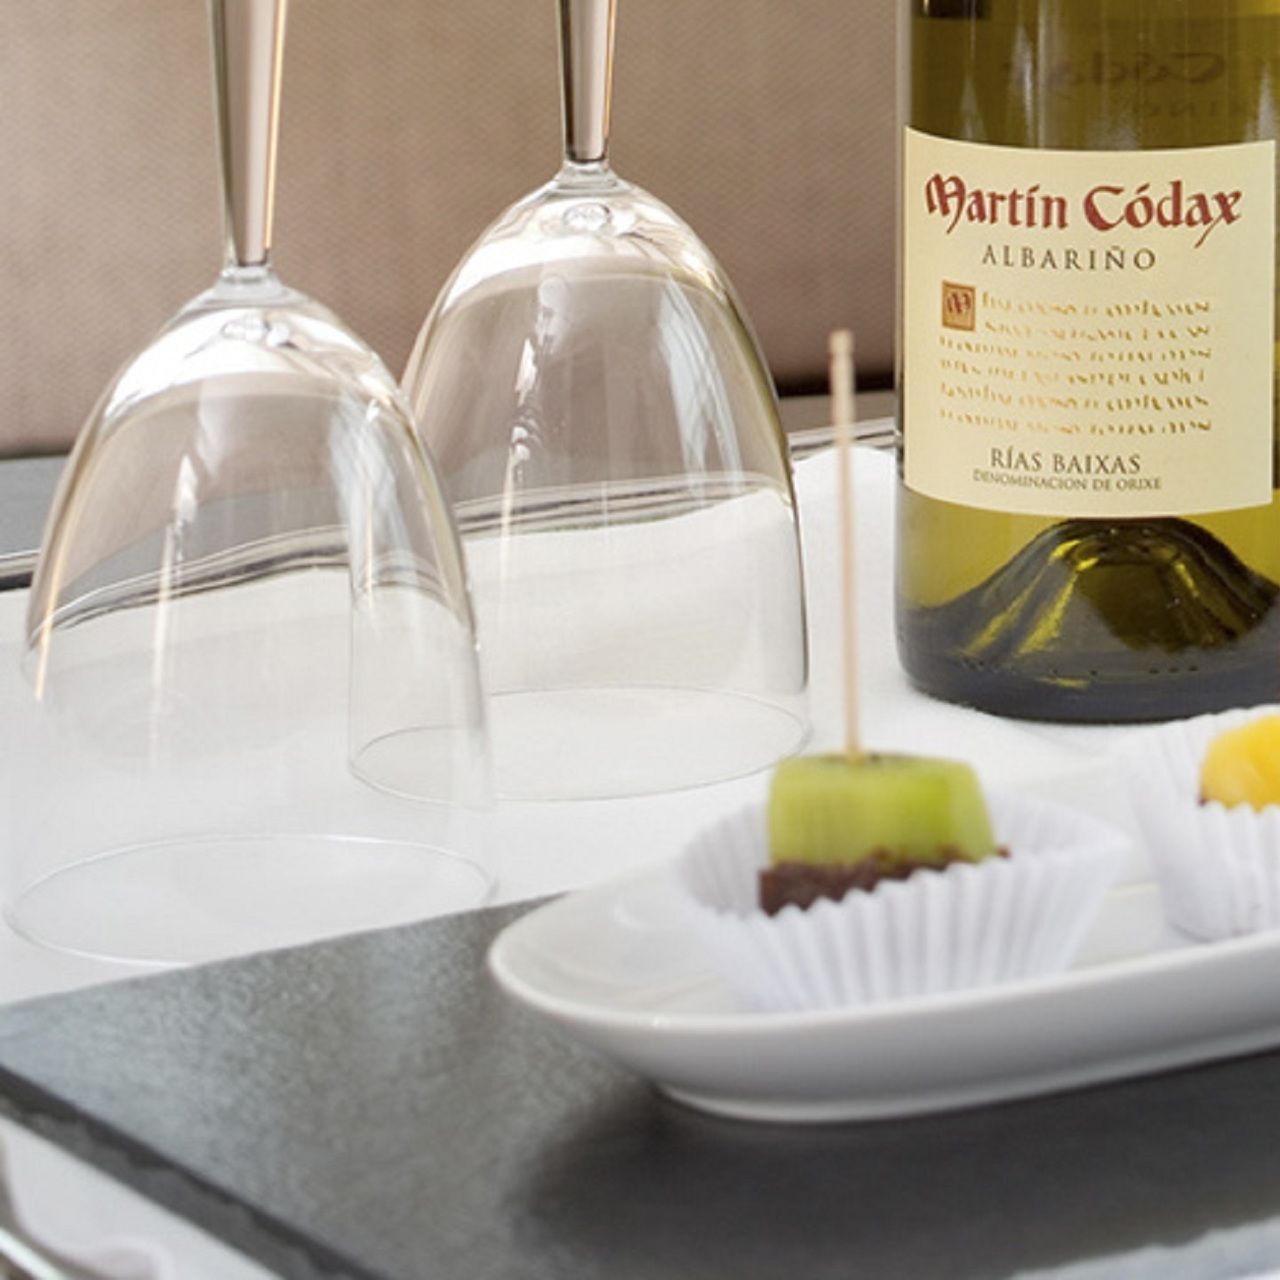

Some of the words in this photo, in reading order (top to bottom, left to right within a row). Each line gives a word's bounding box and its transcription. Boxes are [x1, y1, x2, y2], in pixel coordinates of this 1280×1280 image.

[925, 173, 1069, 234] Martín
[1084, 180, 1243, 248] Códax
[981, 244, 1156, 271] ALBARIÑO
[990, 445, 1042, 472] RÍAS
[1052, 453, 1141, 474] BAIXAS
[1092, 478, 1111, 491] DE
[1116, 477, 1162, 491] ORIXE
